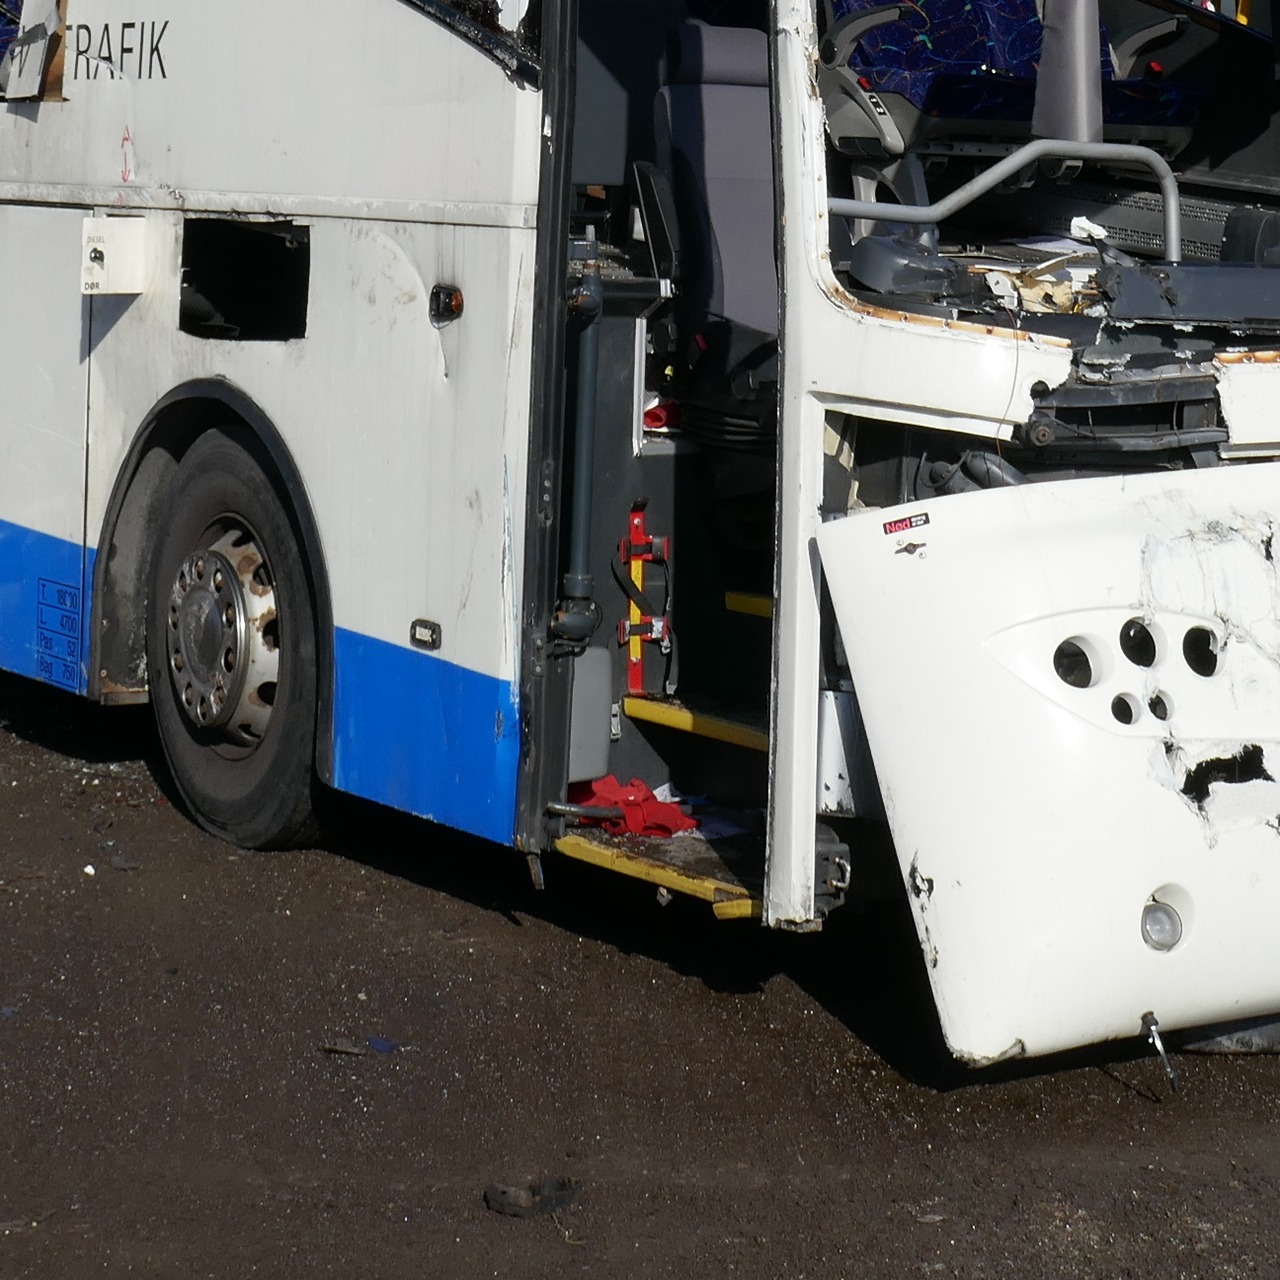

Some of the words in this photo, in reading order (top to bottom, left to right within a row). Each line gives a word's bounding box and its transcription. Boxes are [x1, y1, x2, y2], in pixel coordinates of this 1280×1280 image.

[86, 236, 105, 244] DIESEL
[60, 614, 77, 634] 4700
[67, 639, 76, 658] 52
[62, 663, 76, 683] 750
